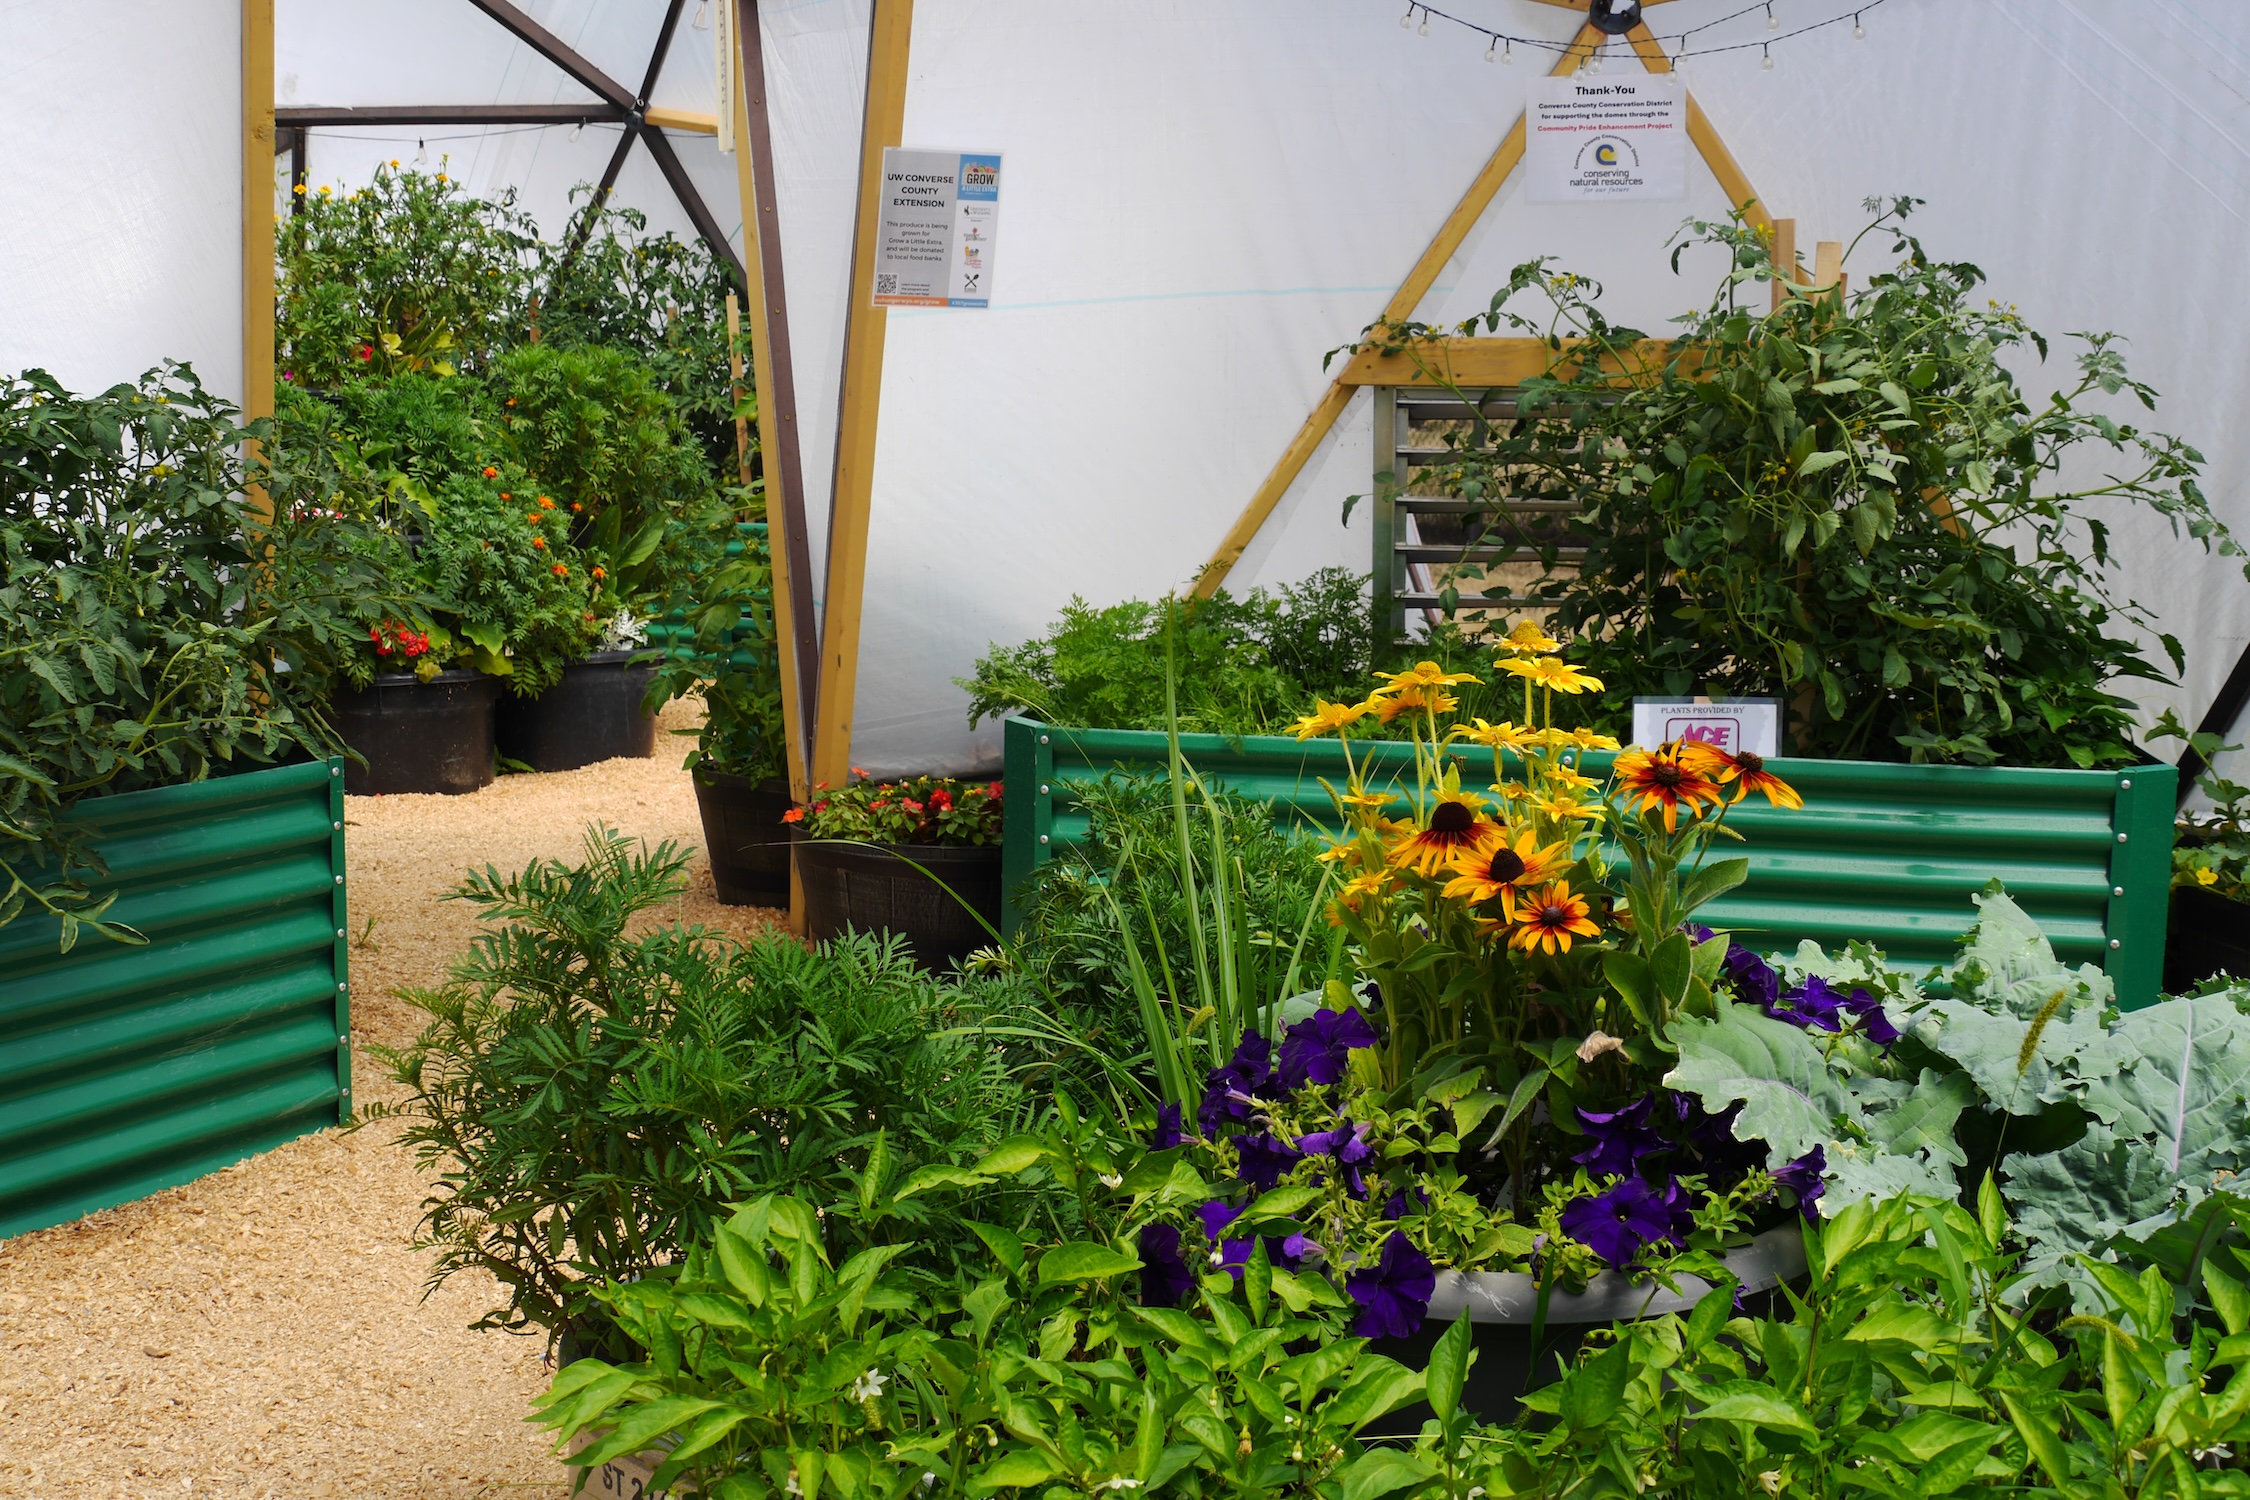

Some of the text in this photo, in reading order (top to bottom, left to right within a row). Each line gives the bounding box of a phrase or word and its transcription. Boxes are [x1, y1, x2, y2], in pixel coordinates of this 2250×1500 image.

[1575, 86, 1635, 95] Thank-You
[1574, 147, 1585, 169] Converse
[1584, 136, 1601, 147] County
[887, 173, 954, 184] UW CONVERSE
[966, 173, 995, 185] GROW
[1583, 168, 1630, 179] conserving
[1569, 177, 1644, 186] natural resources
[901, 186, 939, 195] COUNTY
[893, 198, 945, 208] EXTENSION
[1692, 706, 1732, 714] PROVIDED
[1733, 706, 1745, 714] BY
[1680, 723, 1731, 746] ACE
[602, 1462, 625, 1498] ST
